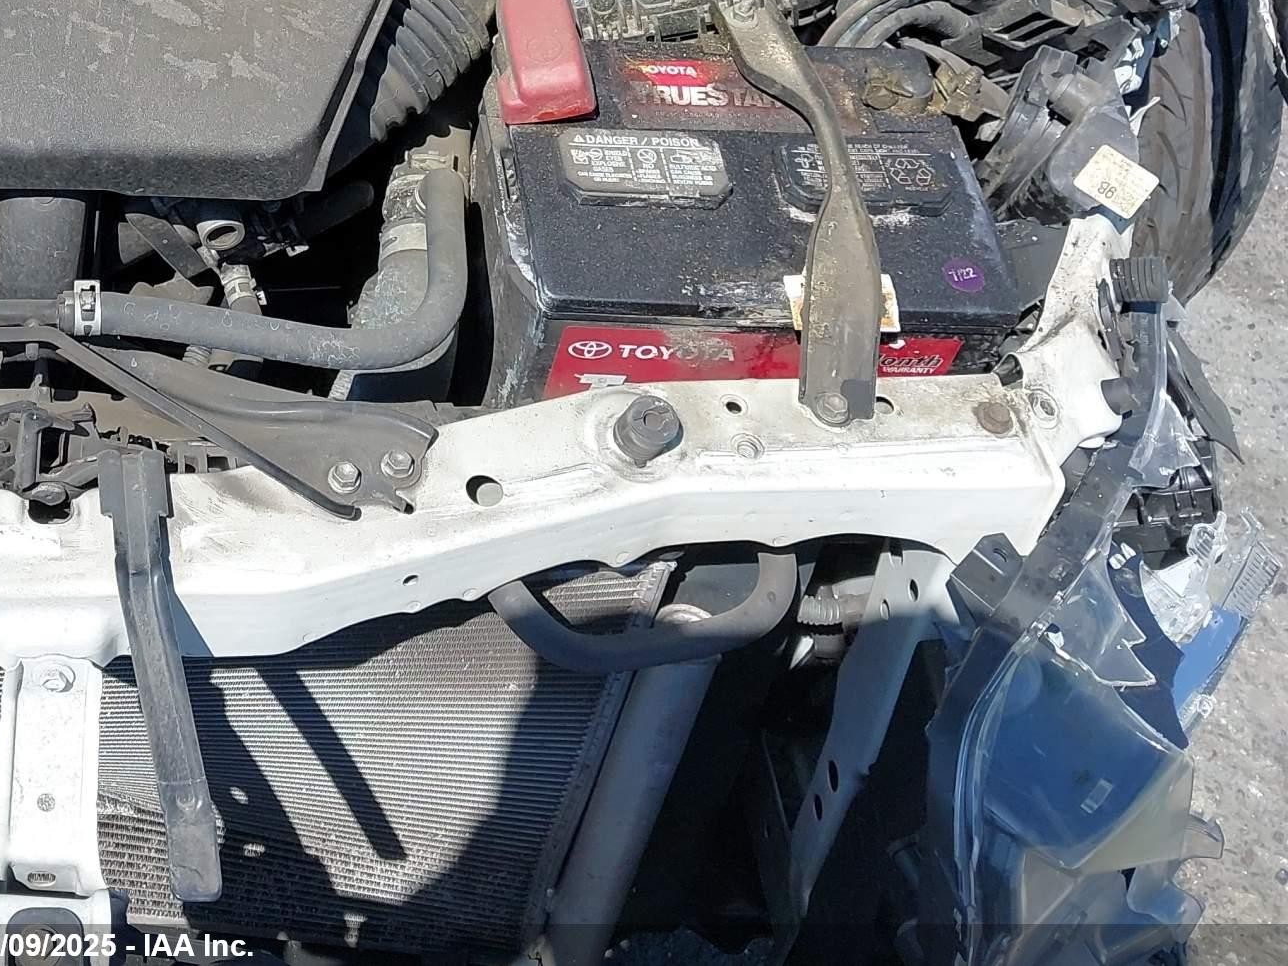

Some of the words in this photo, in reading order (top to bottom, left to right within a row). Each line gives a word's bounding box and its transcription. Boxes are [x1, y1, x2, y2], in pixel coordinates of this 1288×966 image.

[639, 64, 698, 79] TOYOTA
[585, 135, 638, 146] DANGER
[651, 137, 700, 148] POISON
[618, 343, 735, 362] TOYOTA
[878, 353, 944, 367] onth
[882, 366, 936, 374] WARRANTY
